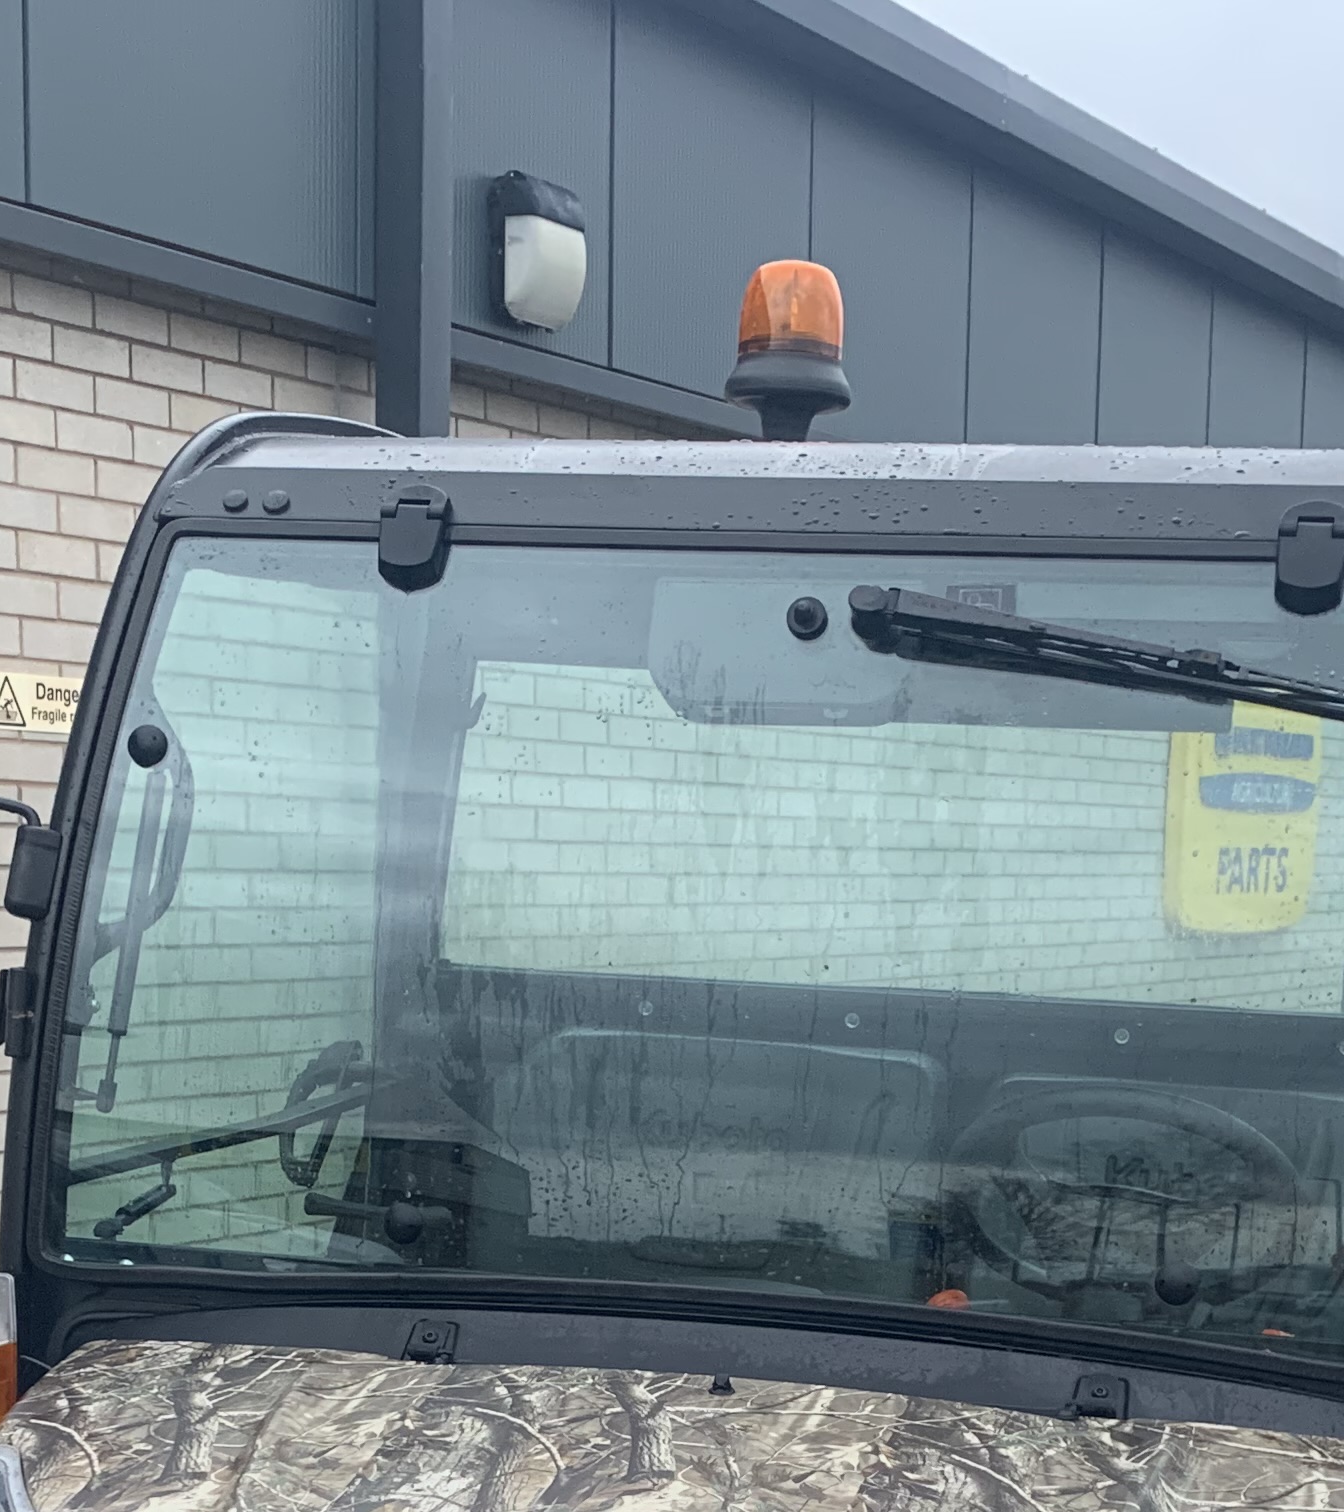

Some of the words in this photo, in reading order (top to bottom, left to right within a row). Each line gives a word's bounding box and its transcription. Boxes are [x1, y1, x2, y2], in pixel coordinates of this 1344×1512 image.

[35, 682, 80, 706] Dange
[31, 706, 67, 724] Fragile
[1215, 844, 1290, 895] PARTS
